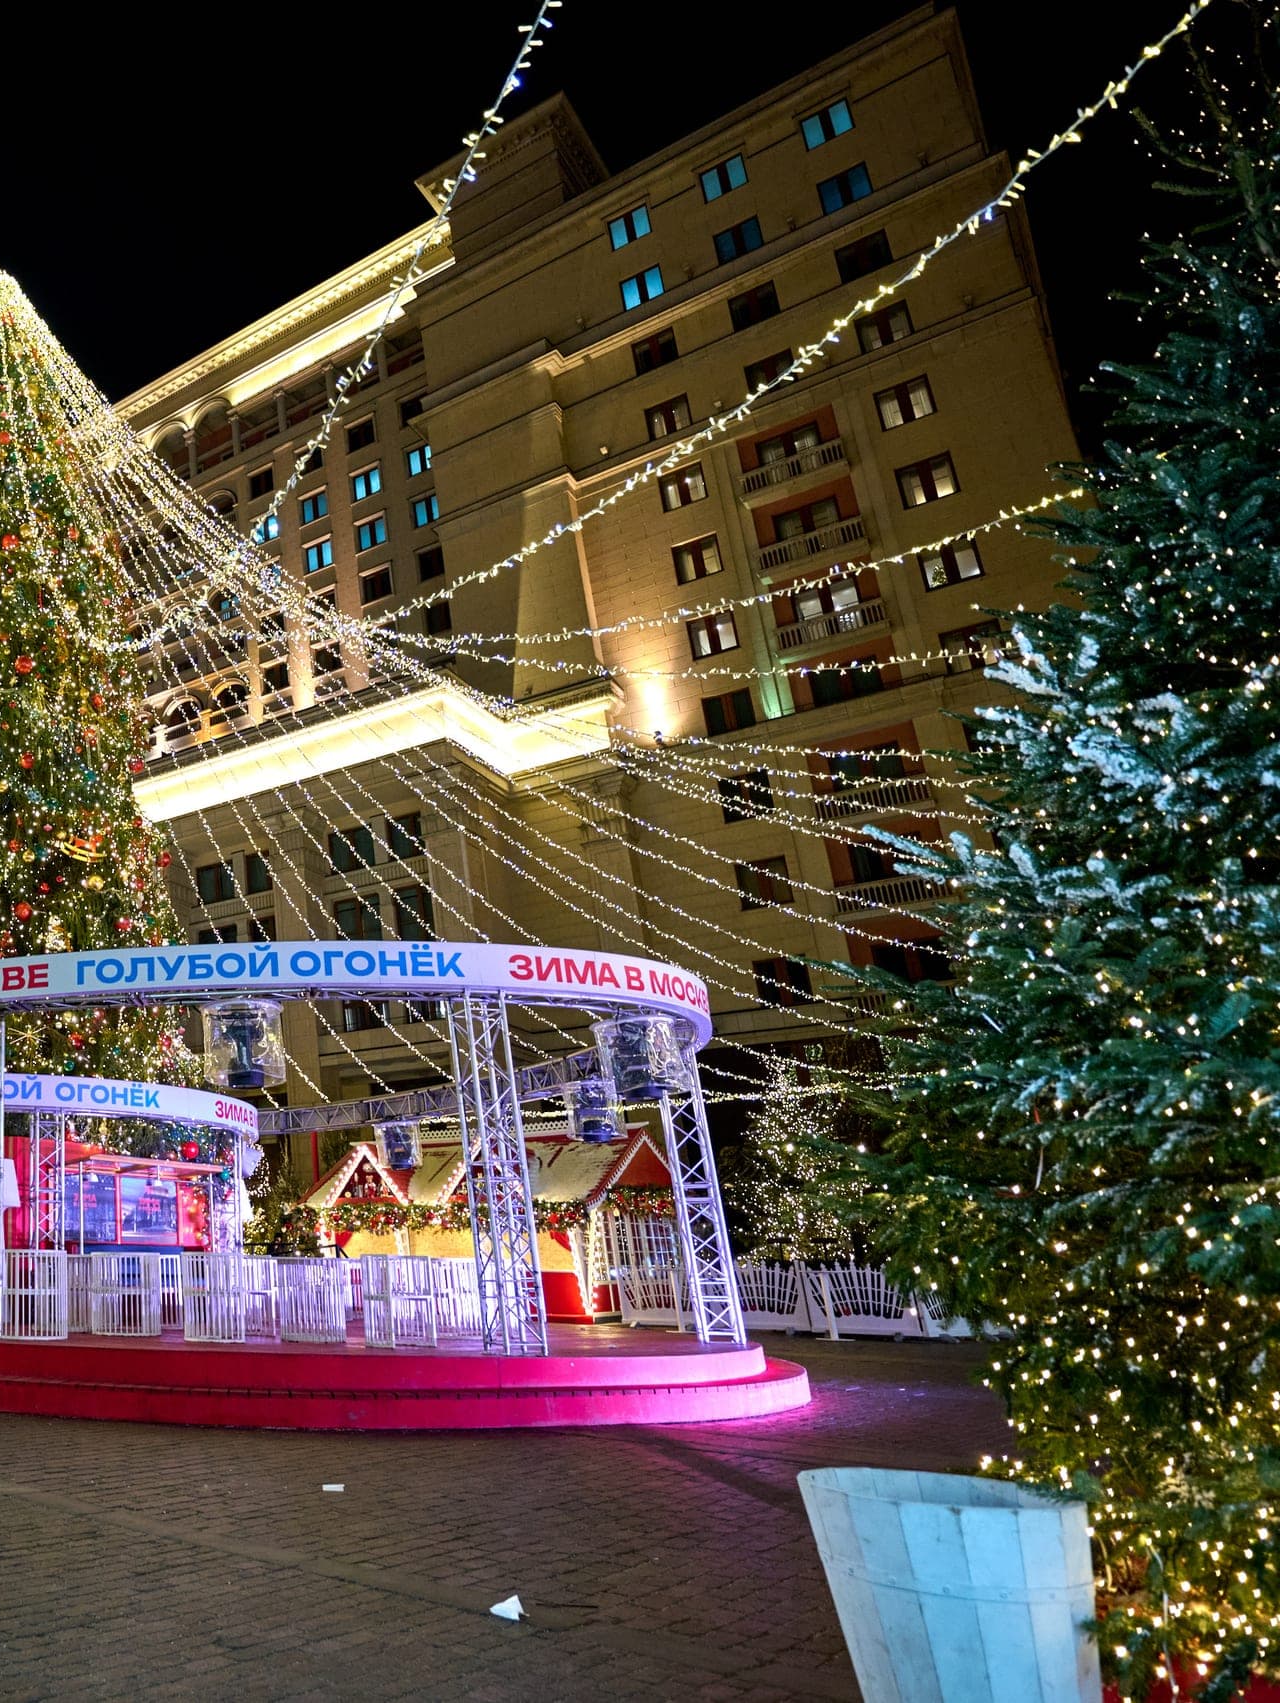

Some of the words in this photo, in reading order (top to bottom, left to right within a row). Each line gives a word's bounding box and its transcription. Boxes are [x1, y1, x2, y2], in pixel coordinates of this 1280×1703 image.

[76, 944, 279, 985] ГОЛУБОЙ
[289, 943, 465, 978] ОГОНЁК
[509, 954, 620, 988] ЗИМА
[624, 965, 645, 991] В
[55, 1083, 160, 1109] ОГОНЁК
[215, 1100, 249, 1124] ЗИМА
